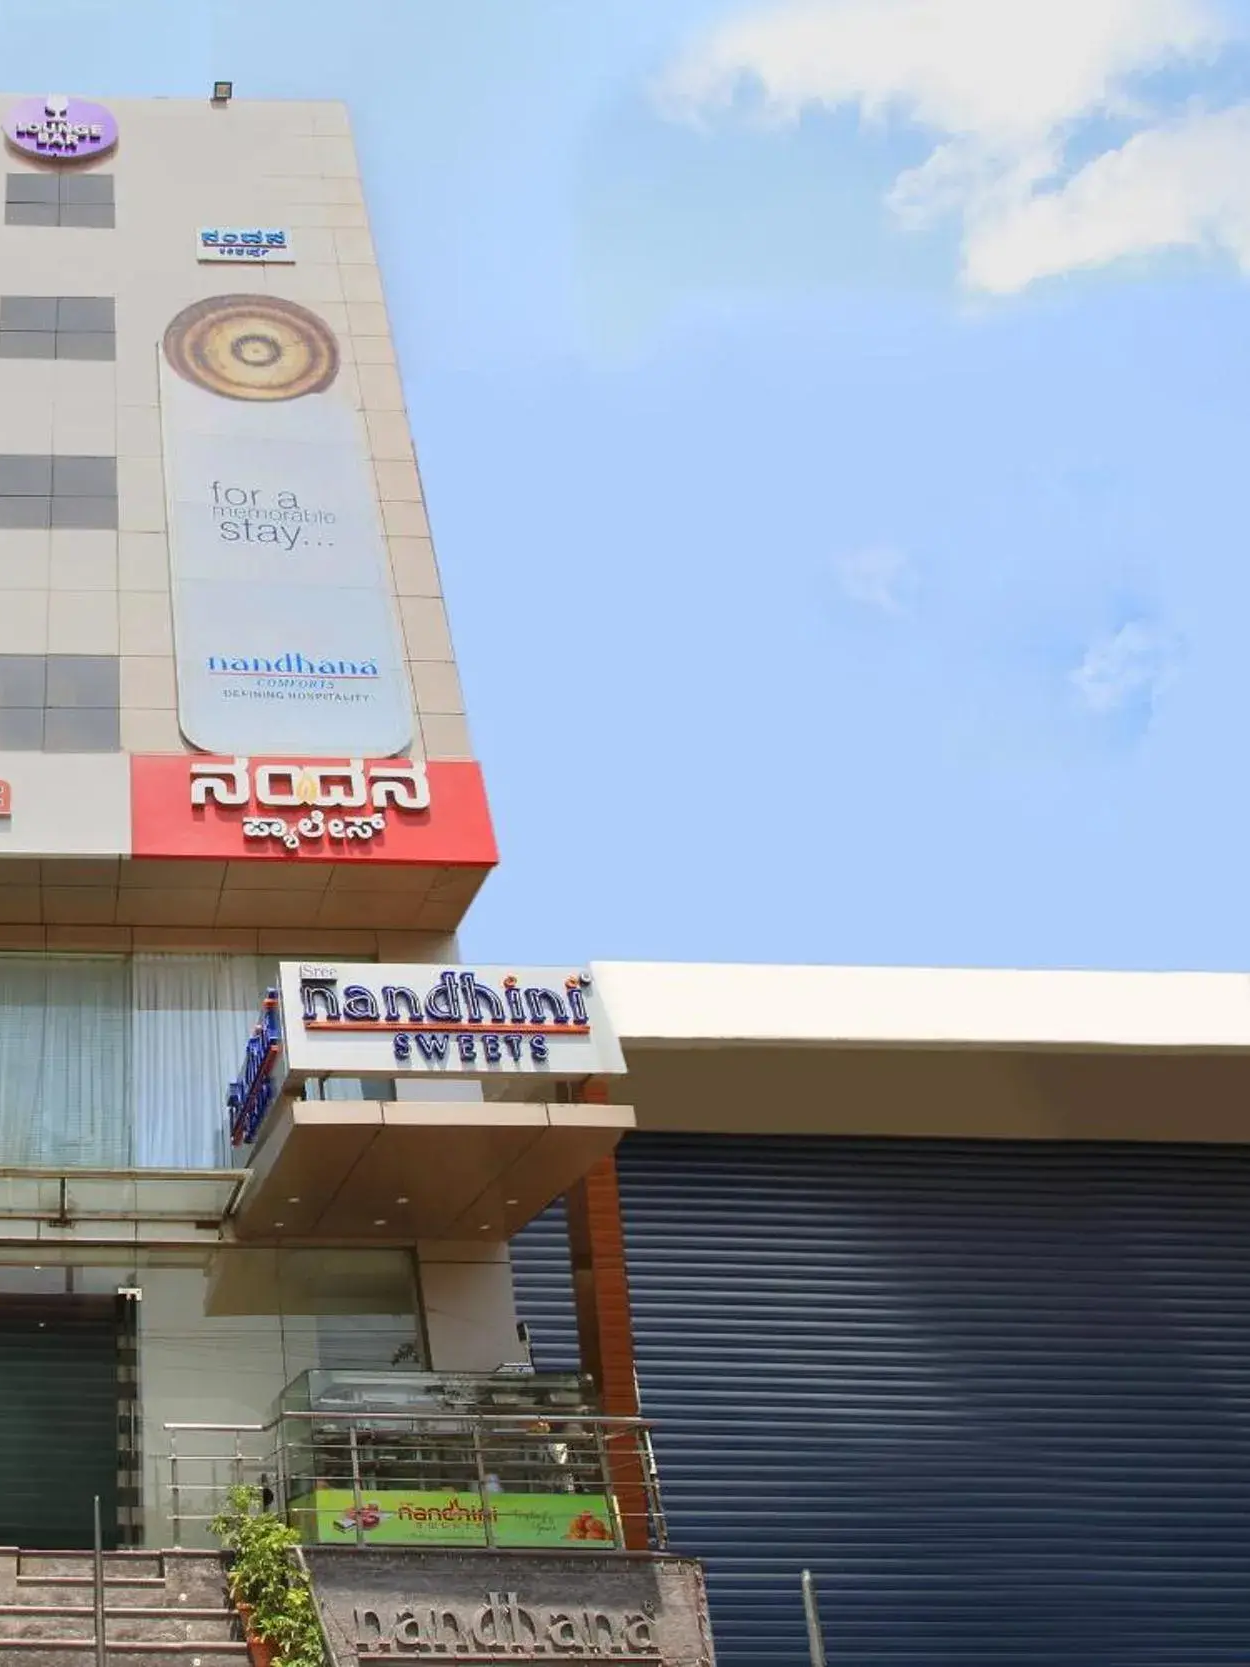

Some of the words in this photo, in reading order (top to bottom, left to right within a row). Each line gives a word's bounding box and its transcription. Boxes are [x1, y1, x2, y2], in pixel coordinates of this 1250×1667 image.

[15, 121, 102, 142] LOUNGE
[36, 131, 78, 151] BAR
[211, 480, 261, 506] for
[277, 490, 300, 509] a
[208, 652, 378, 676] nandhana
[223, 689, 285, 700] DEFINING
[287, 691, 370, 702] HOSPITALITY
[256, 677, 335, 690] COMFORTS
[190, 757, 431, 811] ನಂದನ
[301, 970, 590, 1026] nandhini
[392, 1031, 551, 1064] SWEETS
[353, 1591, 657, 1652] nandhana
